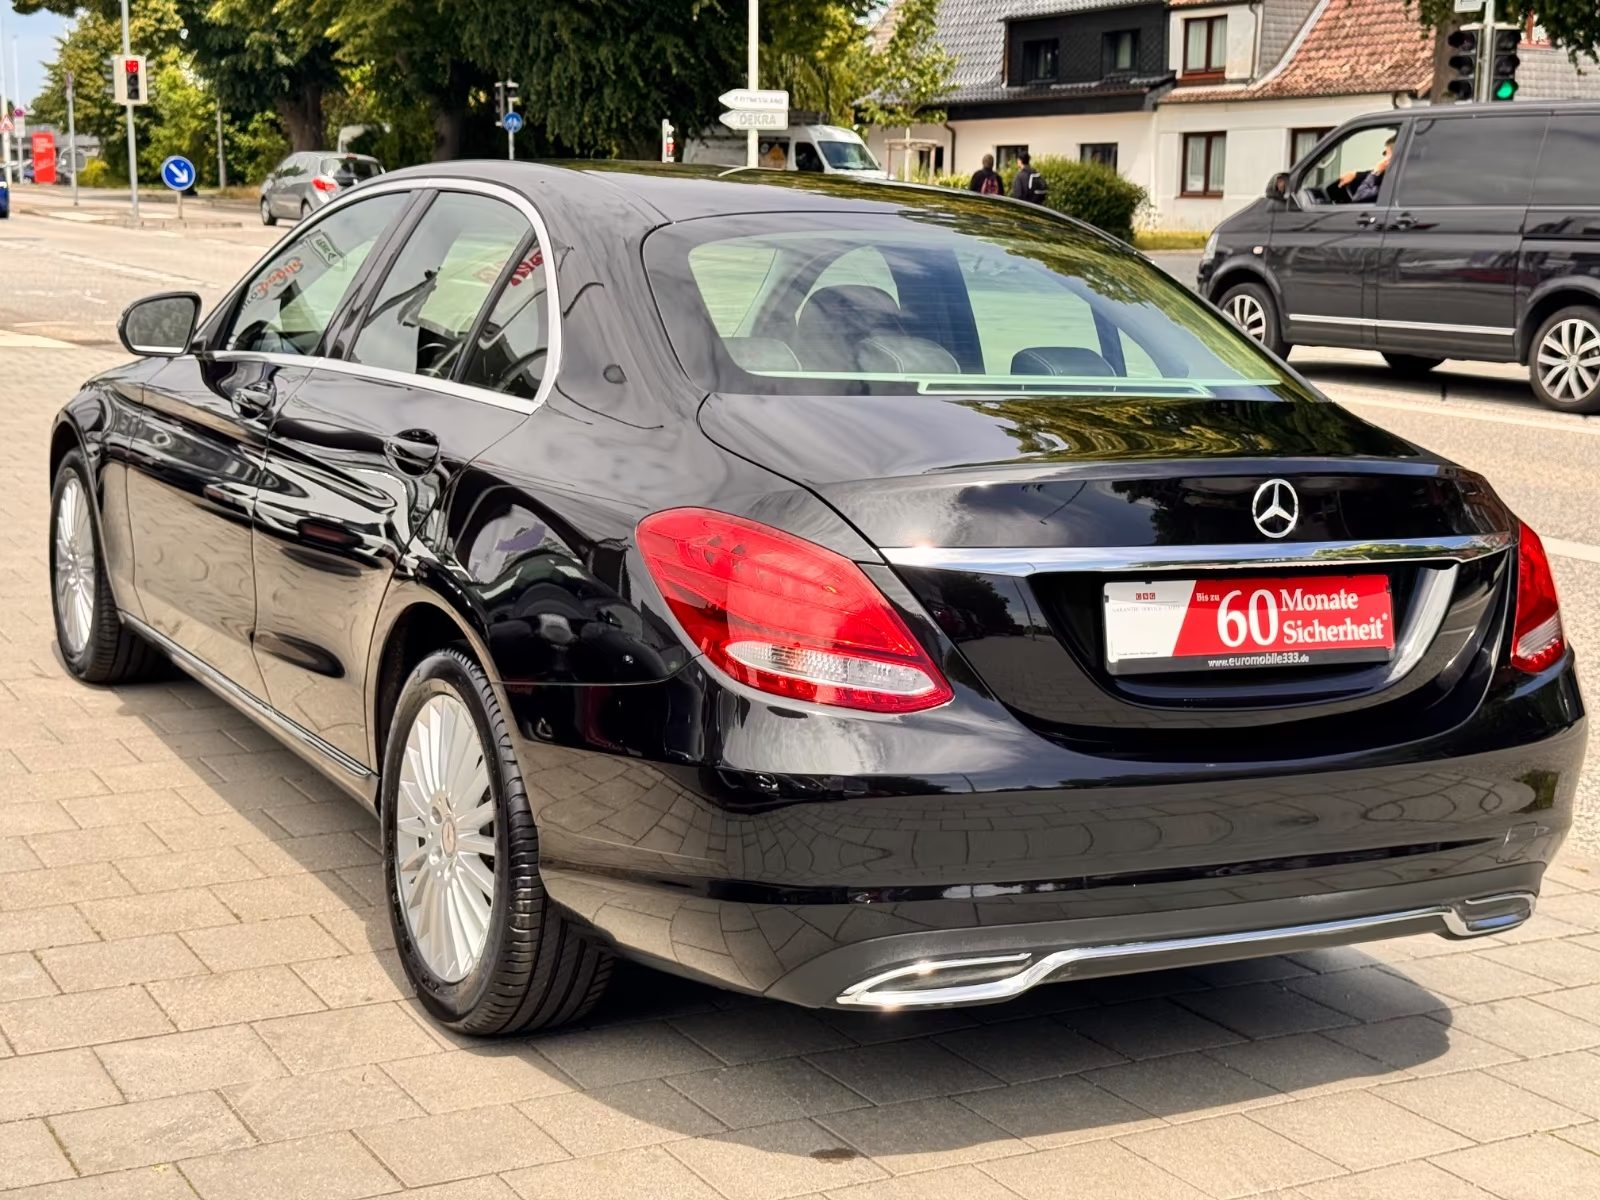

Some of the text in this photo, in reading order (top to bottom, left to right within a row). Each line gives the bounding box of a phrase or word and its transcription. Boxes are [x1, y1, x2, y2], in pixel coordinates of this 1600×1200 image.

[739, 113, 777, 125] DEKRA
[1280, 588, 1359, 611] Monate
[1196, 589, 1279, 647] Bis zu 60
[1208, 652, 1310, 667] www.euromobile333.de
